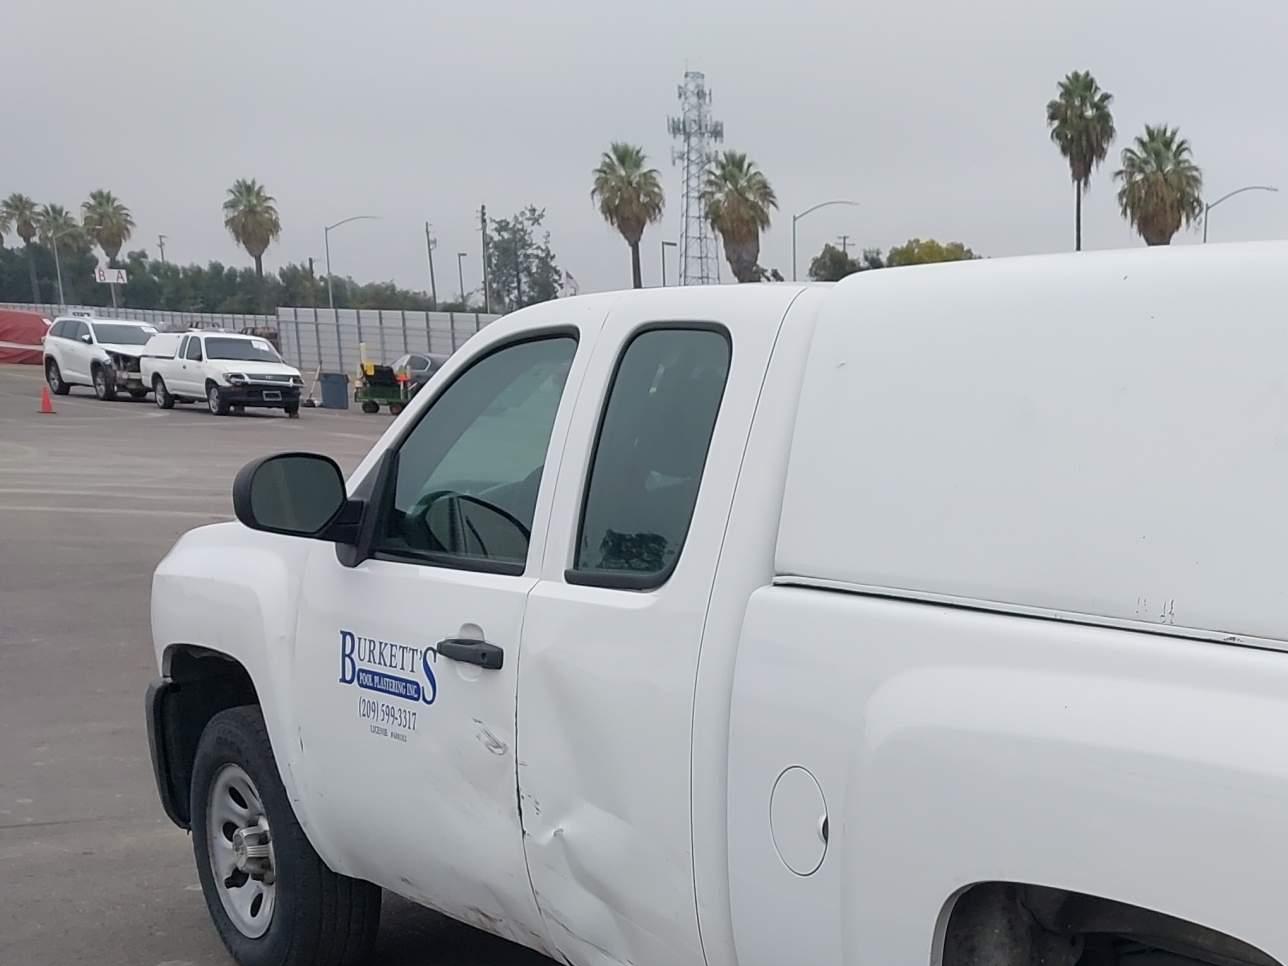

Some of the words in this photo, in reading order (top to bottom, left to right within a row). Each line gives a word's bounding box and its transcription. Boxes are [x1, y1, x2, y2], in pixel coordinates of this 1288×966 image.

[98, 269, 106, 282] B
[116, 270, 126, 283] A
[339, 630, 438, 705] BURKETT'S
[359, 671, 373, 687] POOL
[374, 675, 406, 696] PLASTERING
[358, 696, 379, 722] (209)
[381, 703, 417, 731] 599-3317
